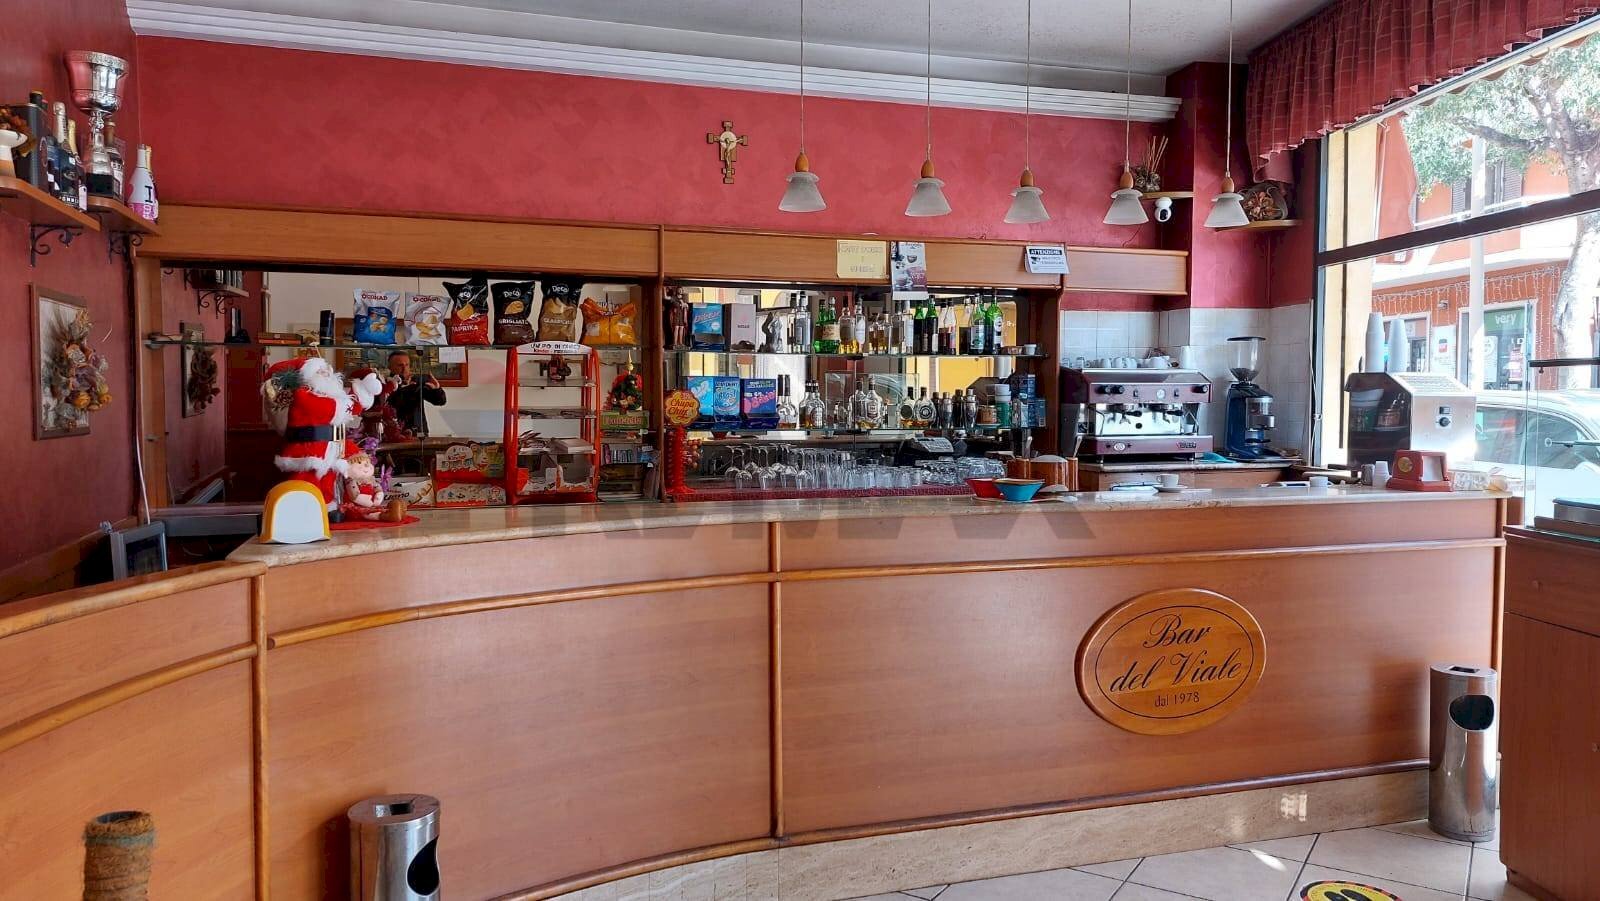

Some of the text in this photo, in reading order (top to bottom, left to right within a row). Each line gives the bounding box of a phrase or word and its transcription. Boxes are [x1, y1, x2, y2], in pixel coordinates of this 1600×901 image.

[1142, 614, 1212, 648] Bar
[1109, 647, 1242, 693] del Viale
[1154, 691, 1200, 708] dal 1978
